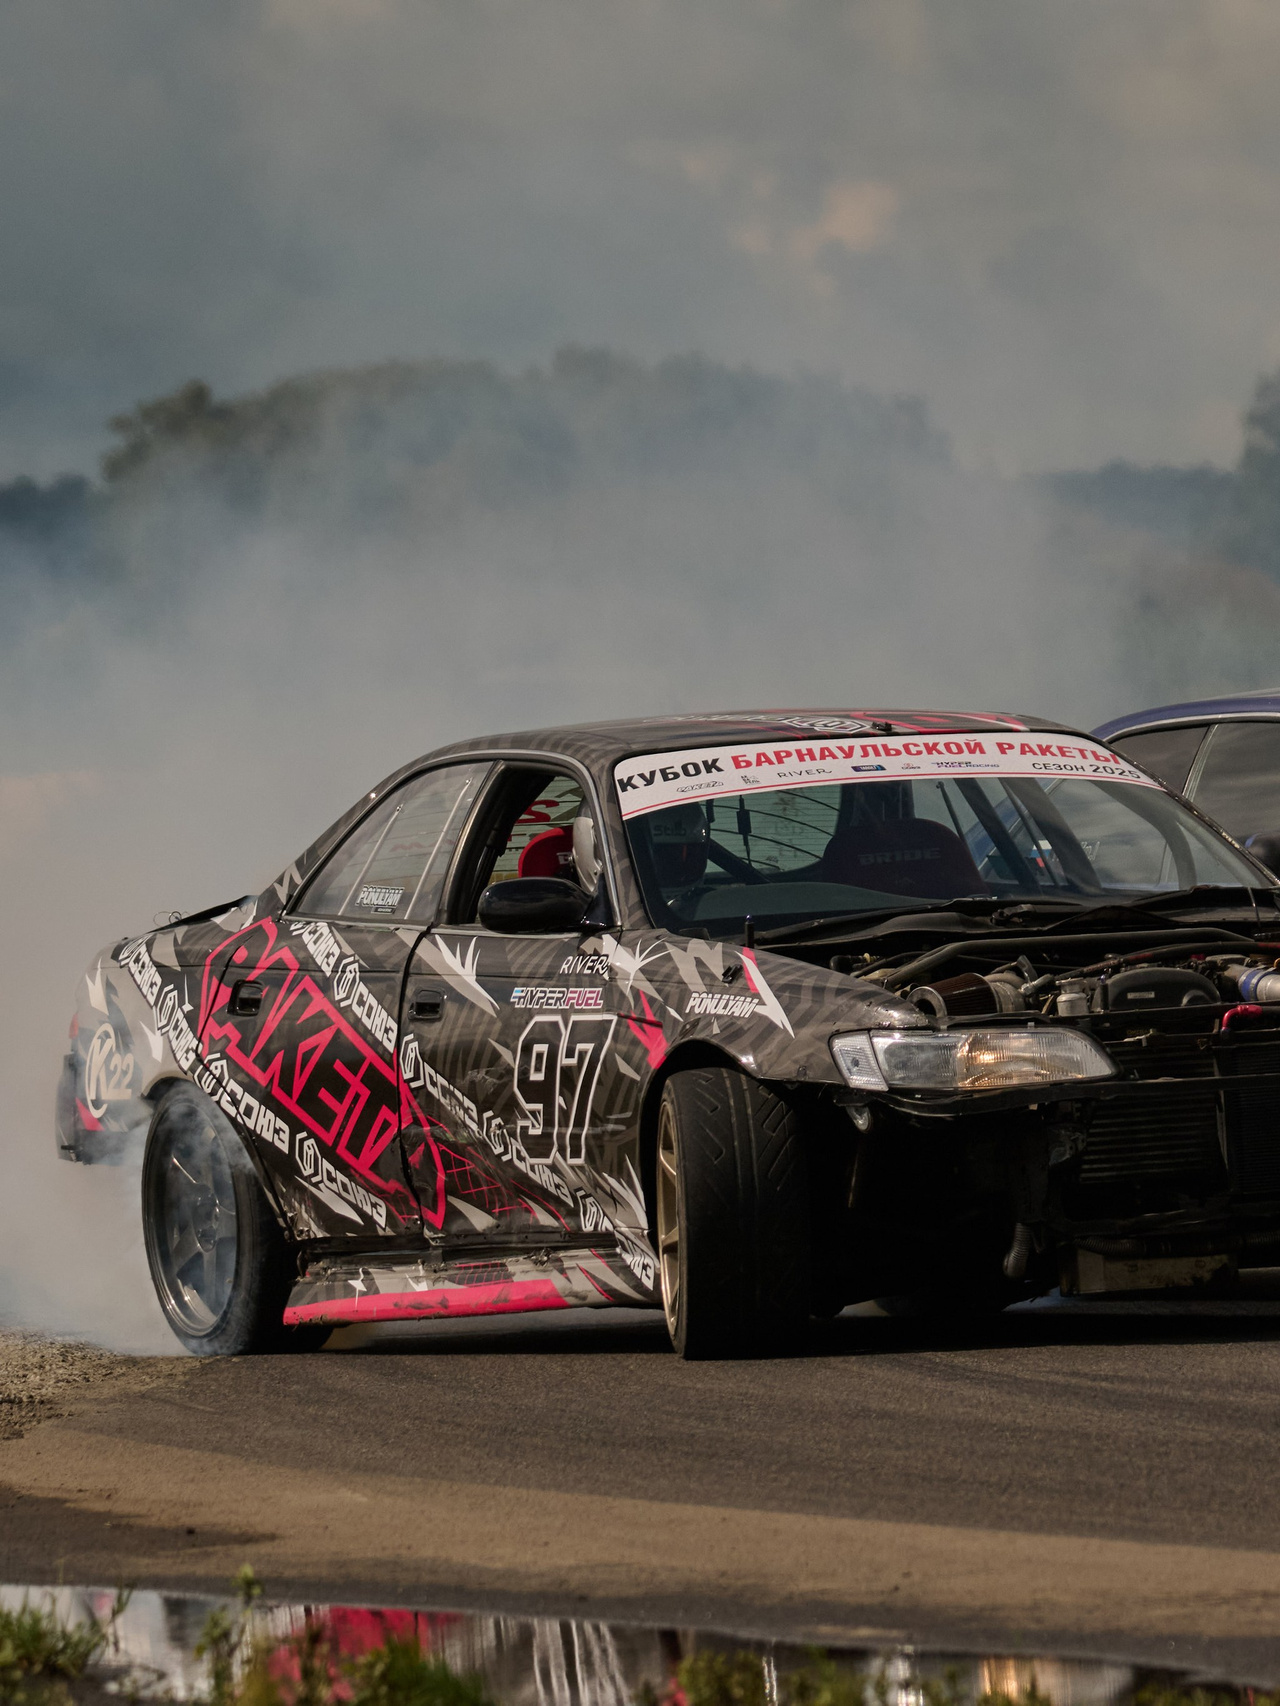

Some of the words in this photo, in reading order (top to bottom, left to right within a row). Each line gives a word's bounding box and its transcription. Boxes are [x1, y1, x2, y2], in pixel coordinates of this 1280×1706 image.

[617, 757, 724, 793] КУБОК
[731, 739, 986, 770] БАРНАУЛЬСКОЙ
[995, 742, 1121, 765] РАКЕТЫ
[777, 768, 832, 779] RIVER
[1032, 762, 1085, 773] СЕЗОН
[1091, 763, 1141, 779] 2025
[858, 847, 941, 866] BRIDE
[560, 955, 611, 977] RIVER
[351, 980, 398, 1054] СОЮЗ
[685, 992, 759, 1018] PONULYAM
[128, 943, 163, 1008] СОЮЗ
[168, 1006, 203, 1073] СОЮЗ
[220, 1078, 290, 1155] СОЮЗ
[322, 1157, 387, 1229] СОЮЗ
[513, 1013, 618, 1166] 97
